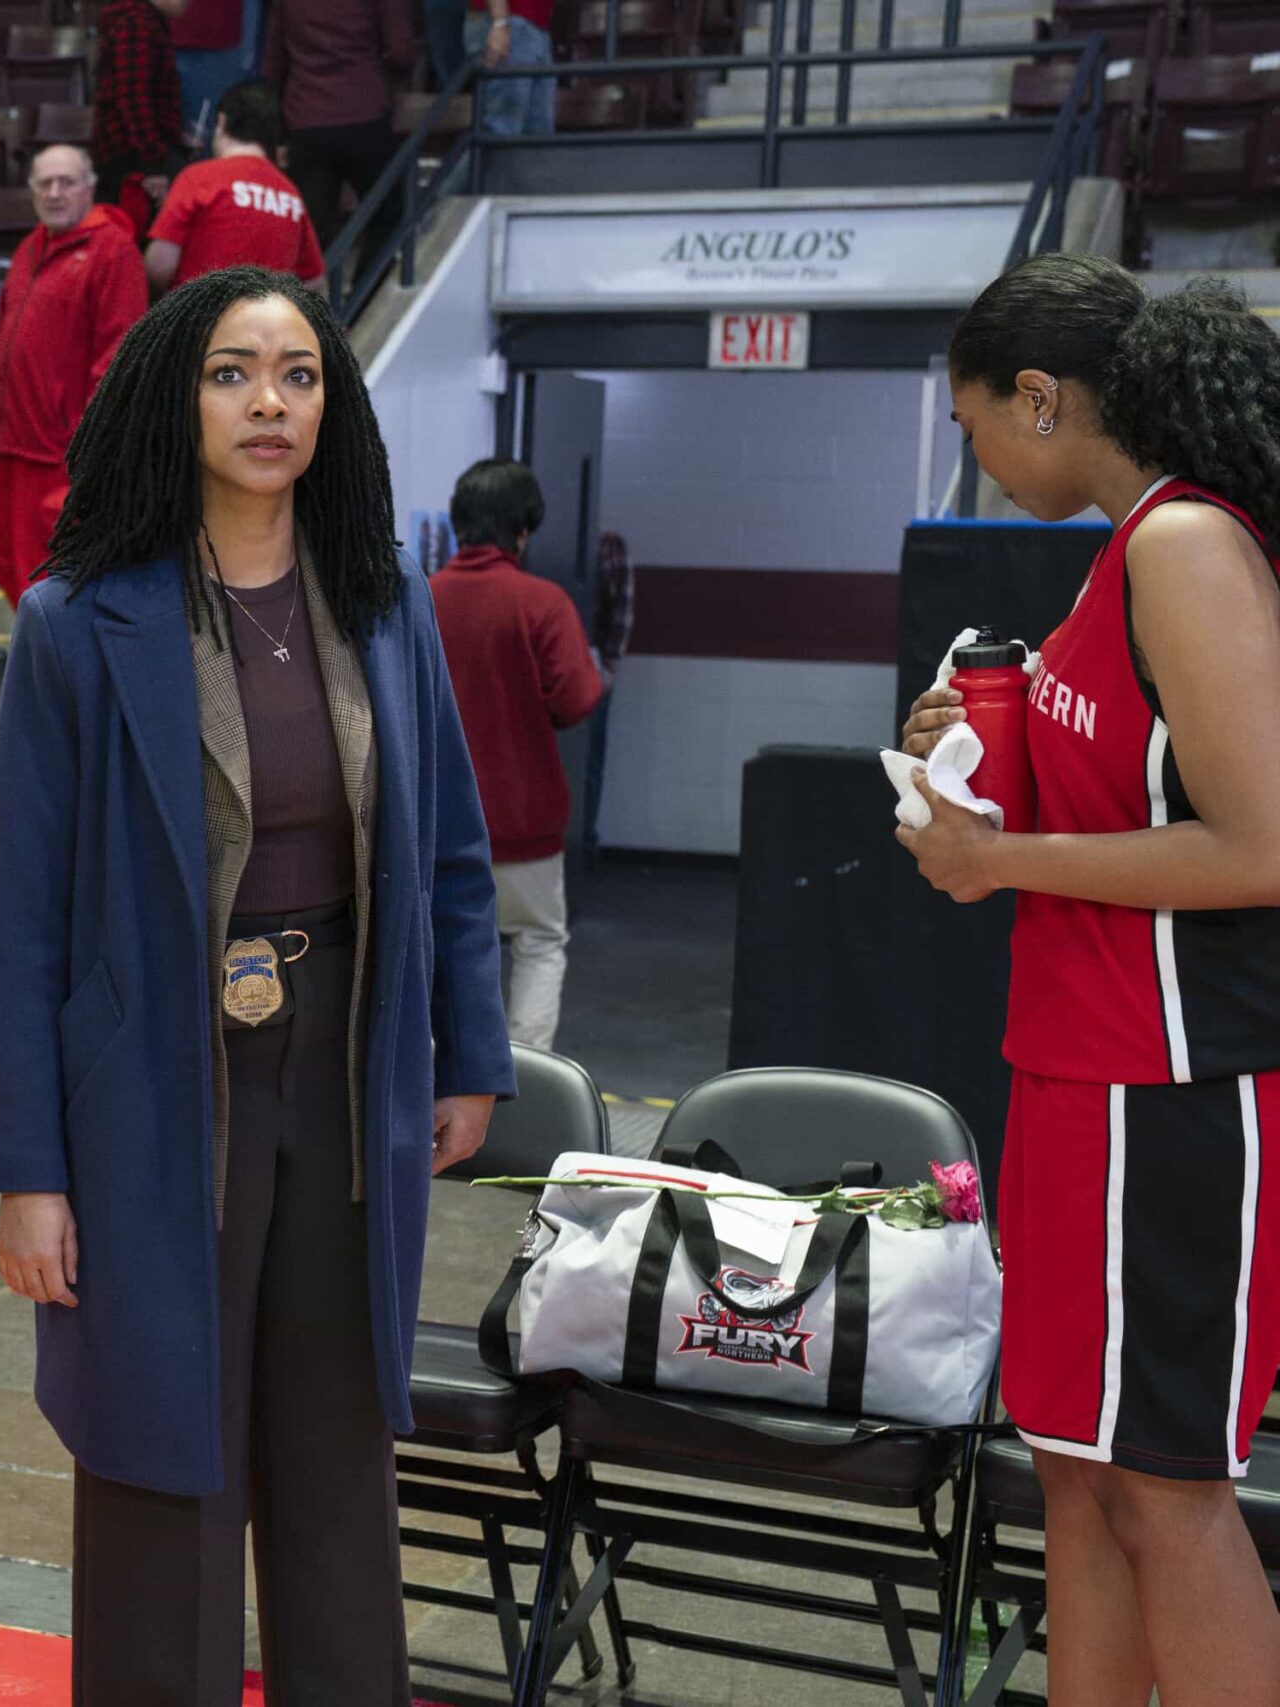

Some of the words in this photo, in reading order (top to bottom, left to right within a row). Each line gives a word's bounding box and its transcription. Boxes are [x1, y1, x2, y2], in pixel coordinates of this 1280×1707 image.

[232, 180, 305, 223] STAFF
[660, 228, 855, 262] ANGULO'S
[721, 315, 795, 363] EXIT
[231, 955, 271, 967] BOSTON
[233, 966, 269, 979] POLICE
[691, 1322, 801, 1357] FURY
[717, 1348, 771, 1360] NORTHERN
